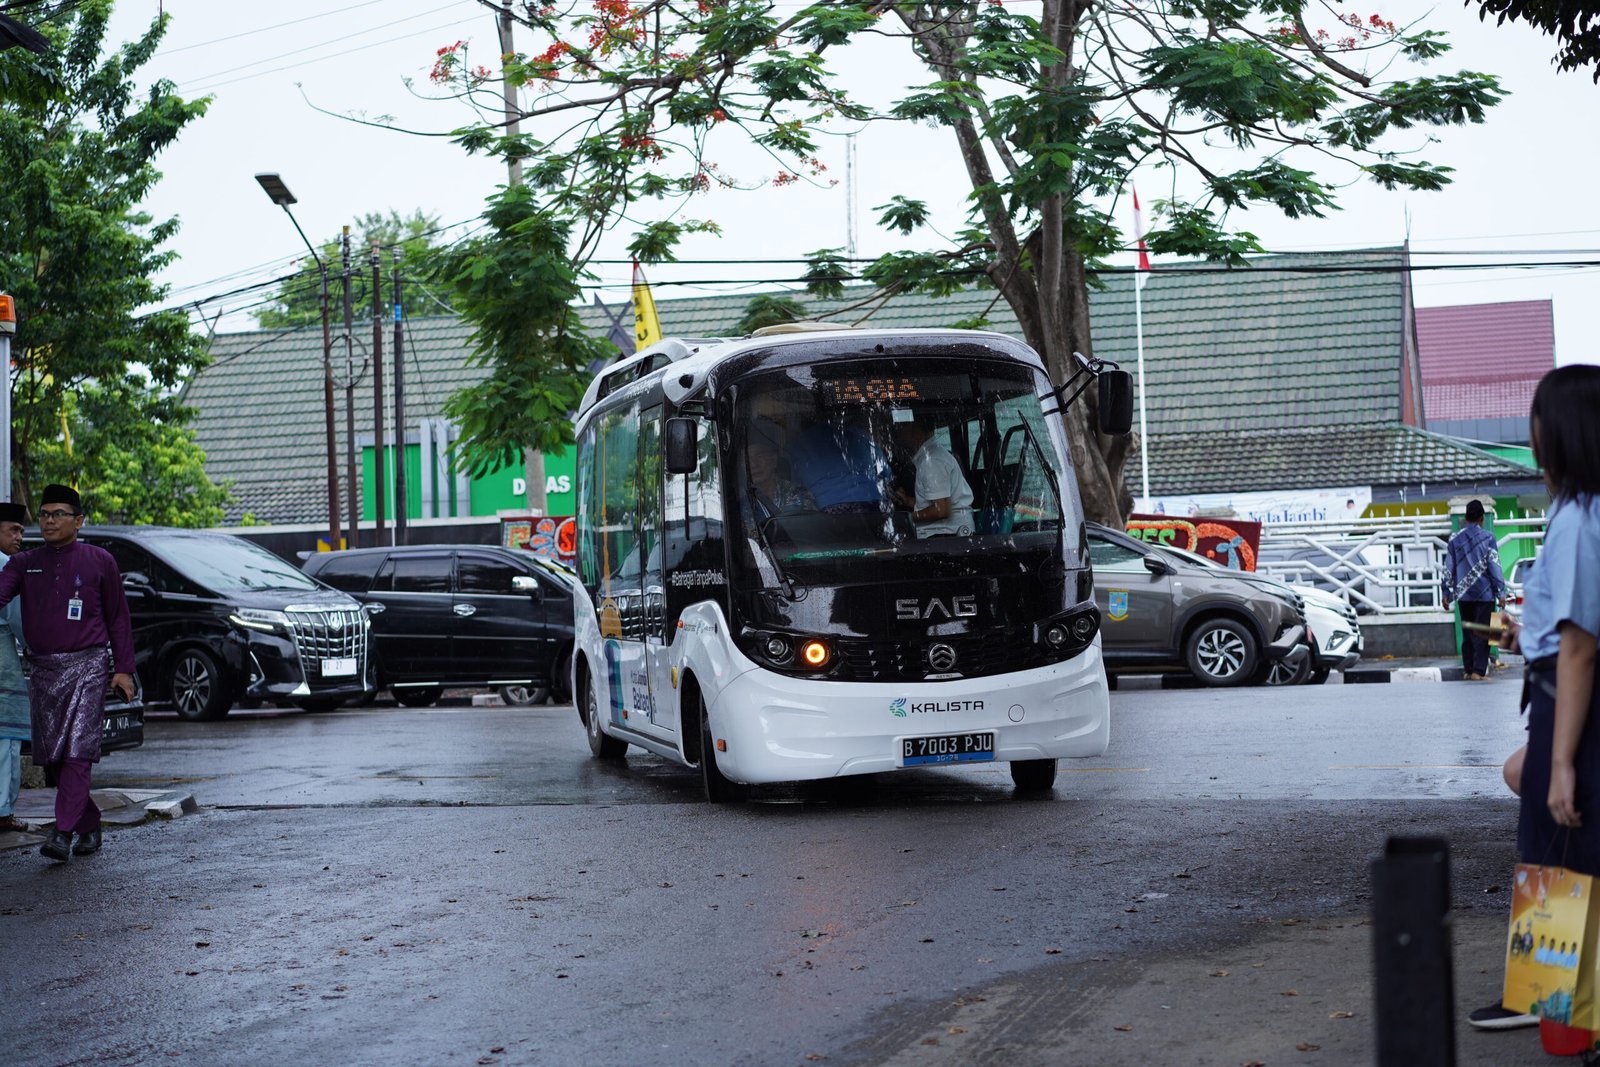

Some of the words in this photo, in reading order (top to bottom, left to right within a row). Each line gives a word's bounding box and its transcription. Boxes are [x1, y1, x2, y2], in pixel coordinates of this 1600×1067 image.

[513, 476, 570, 494] DAS
[896, 594, 977, 620] SAG
[911, 700, 984, 713] KALISTA
[904, 740, 913, 757] B
[918, 737, 957, 755] 7003
[965, 734, 993, 751] PJU
